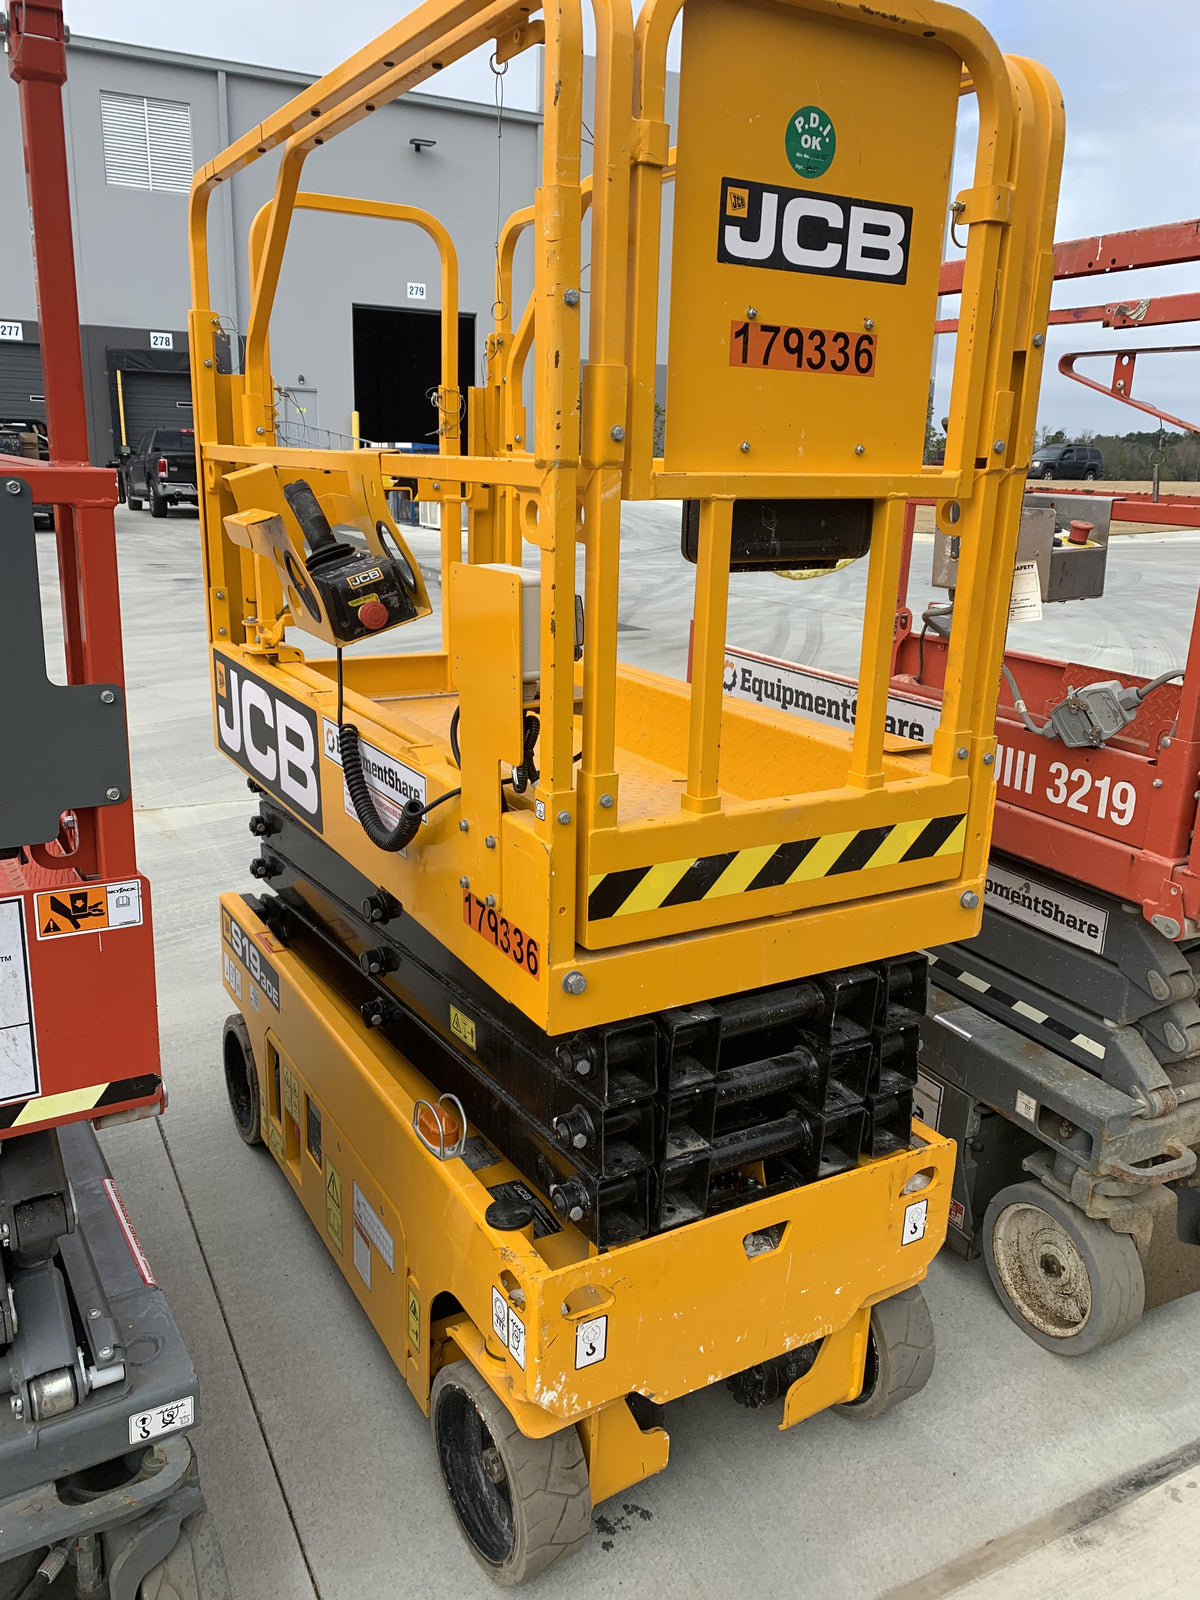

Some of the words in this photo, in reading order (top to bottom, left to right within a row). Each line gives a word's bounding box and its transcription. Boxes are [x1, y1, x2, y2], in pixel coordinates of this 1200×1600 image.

[801, 134, 822, 151] OK
[730, 192, 746, 211] JCB
[724, 191, 906, 276] JCB
[409, 286, 424, 297] 279
[0, 325, 19, 337] 277
[152, 336, 170, 347] 278
[734, 322, 874, 374] 179336
[352, 570, 380, 586] JCB
[740, 667, 925, 742] Equipmentare
[218, 669, 318, 815] JCB
[336, 735, 420, 800] EmentShare
[1046, 761, 1137, 826] 3219
[464, 892, 539, 976] 179336
[984, 877, 1099, 940] pmentShare
[513, 1184, 532, 1201] JCB
